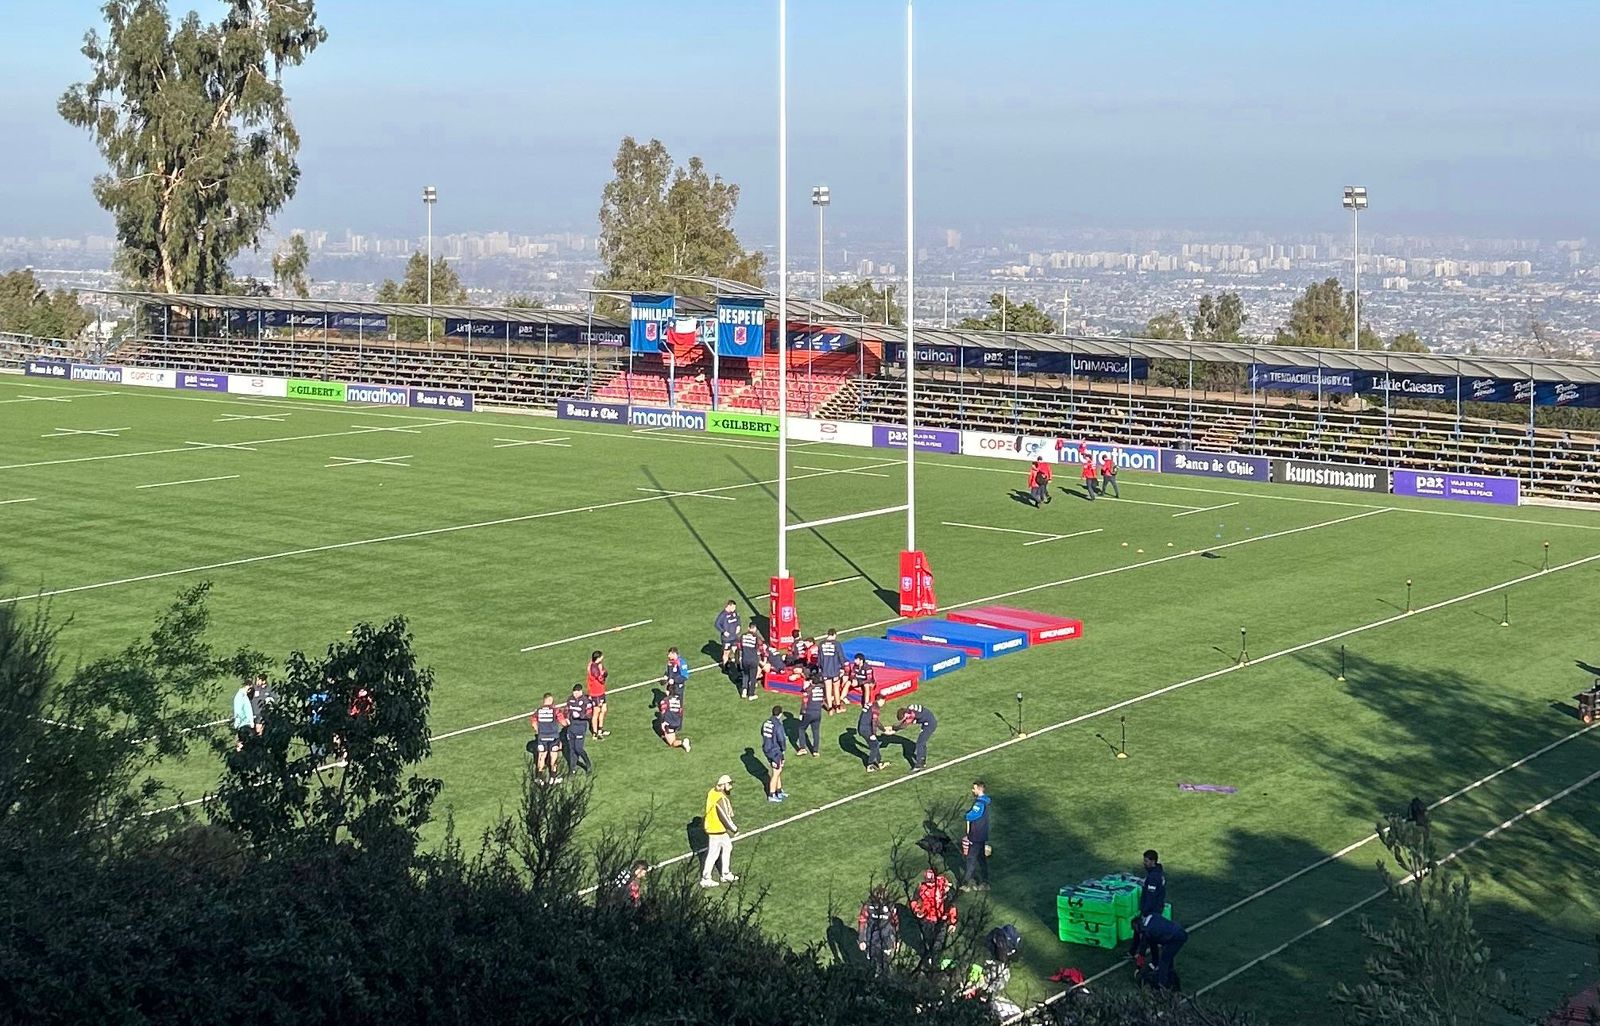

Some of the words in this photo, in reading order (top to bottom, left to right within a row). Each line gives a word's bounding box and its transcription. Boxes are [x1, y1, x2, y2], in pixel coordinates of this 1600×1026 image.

[719, 308, 763, 325] RESPETO
[984, 352, 1003, 362] pax
[73, 367, 121, 382] marathon
[297, 385, 335, 398] GILBERT
[1402, 379, 1446, 394] Caesars
[347, 388, 406, 405] marathon
[566, 403, 590, 417] Banco
[591, 406, 599, 418] de
[600, 407, 619, 421] Chile
[632, 409, 705, 430] marathon
[721, 419, 773, 433] GILBERT
[1175, 454, 1210, 472] Banco
[1212, 459, 1224, 473] de
[1226, 460, 1255, 476] Chile
[1285, 462, 1377, 489] kunstmann
[1416, 476, 1445, 489] pax
